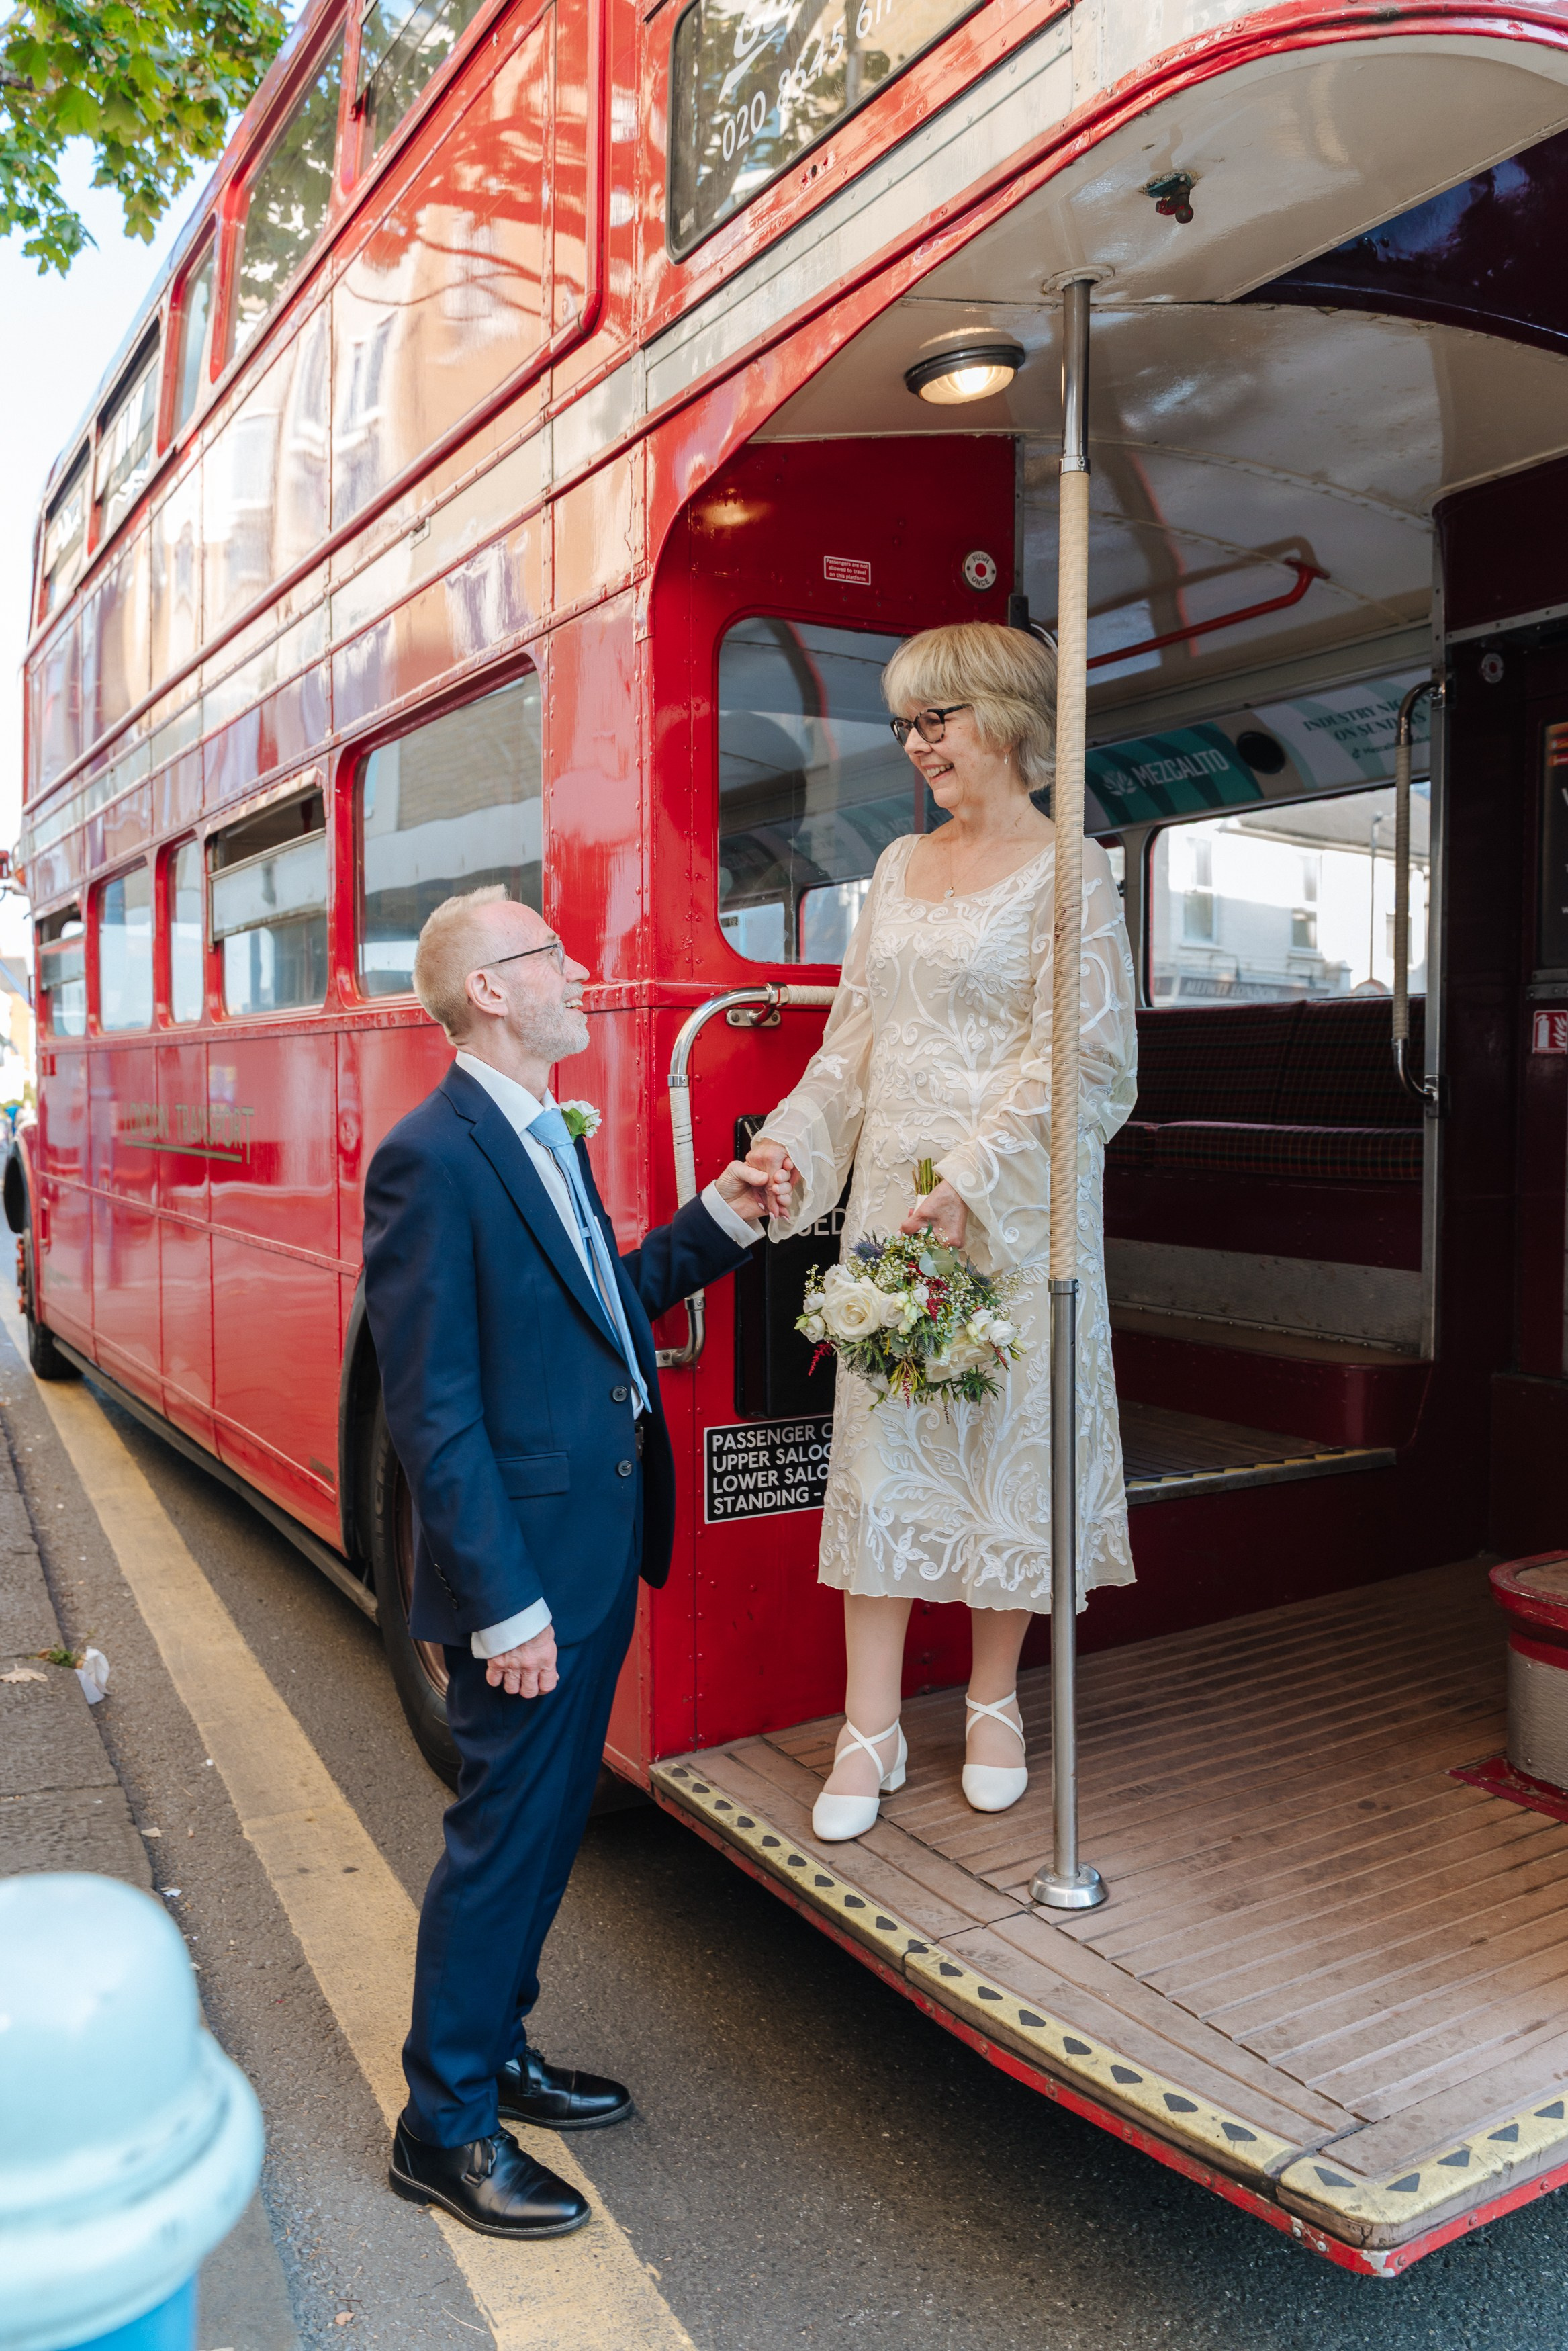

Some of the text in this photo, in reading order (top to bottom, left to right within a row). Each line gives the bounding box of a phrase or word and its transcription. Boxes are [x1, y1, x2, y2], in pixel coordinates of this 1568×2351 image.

[723, 91, 766, 161] 020
[826, 558, 851, 567] Passengers
[972, 554, 990, 564] PUSH
[972, 576, 990, 586] ONCE
[1303, 705, 1375, 731] INDUSTRY
[1334, 722, 1357, 741] ON
[1130, 749, 1230, 787] MEZCALITO
[123, 1102, 255, 1165] LONDON TRANSPORT
[712, 1425, 817, 1452] PASSENGER
[712, 1442, 833, 1472] UPPER SALOO
[712, 1463, 830, 1494] LOWER SALO
[713, 1487, 809, 1515] STANDING
